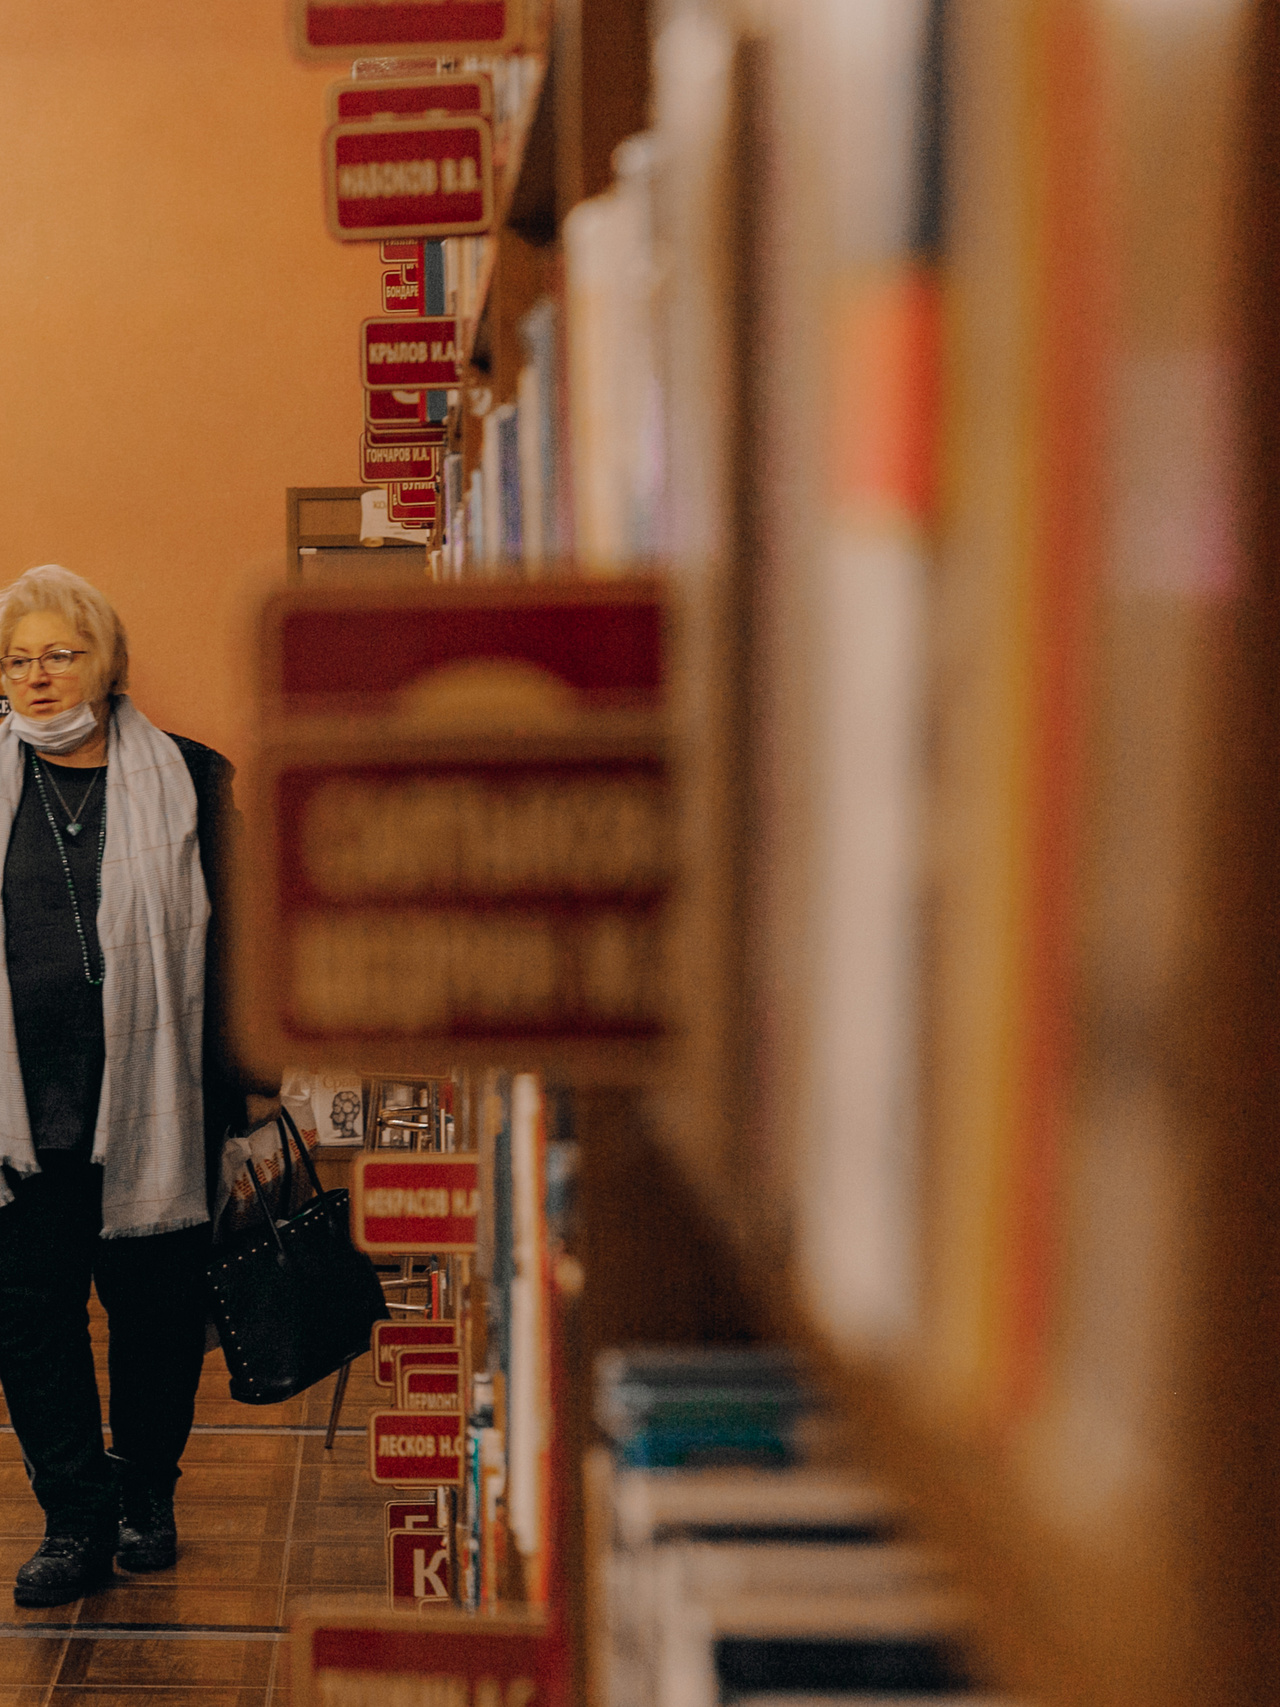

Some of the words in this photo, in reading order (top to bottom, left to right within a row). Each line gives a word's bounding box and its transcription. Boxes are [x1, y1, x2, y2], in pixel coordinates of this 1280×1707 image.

[386, 285, 419, 299] БОНДАРЕ
[369, 342, 427, 364] КРЫЛОВ
[366, 449, 411, 463] ГОНЧАРОВ
[408, 1393, 458, 1408] ЛЕРМОНТ
[379, 1436, 436, 1456] ЛЕСКОВ
[414, 1549, 448, 1597] К
